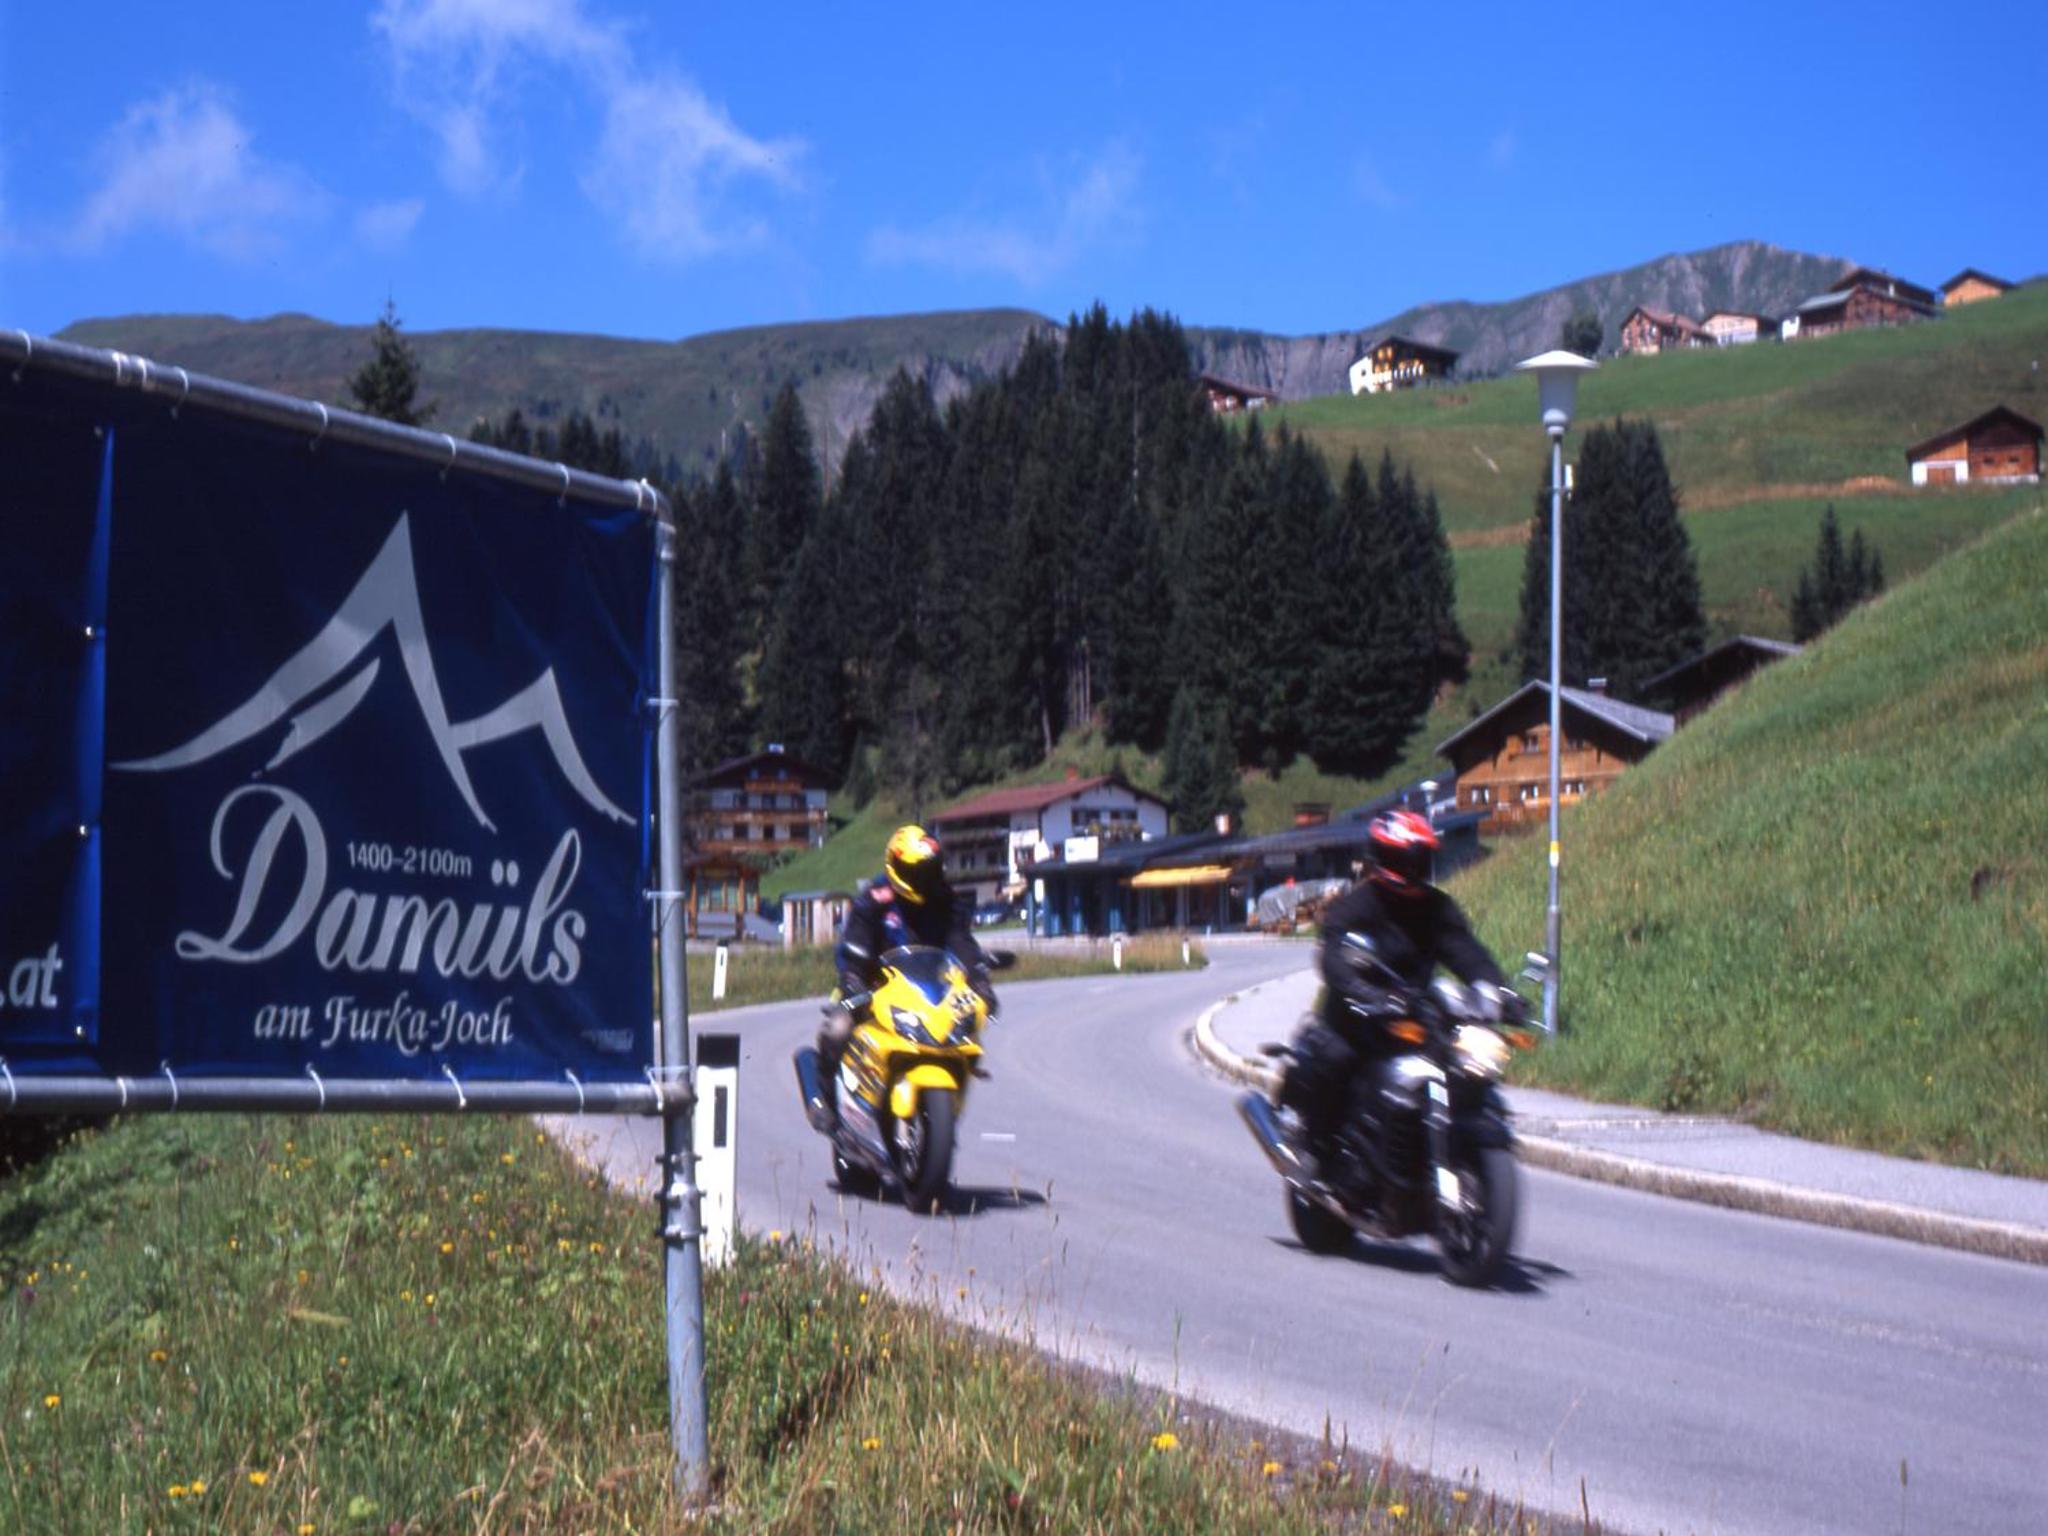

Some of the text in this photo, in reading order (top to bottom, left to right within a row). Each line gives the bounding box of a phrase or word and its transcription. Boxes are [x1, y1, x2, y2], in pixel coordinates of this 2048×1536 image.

[175, 783, 586, 985] Damüls
[347, 841, 472, 877] 1400-2100m
[253, 990, 515, 1058] am Furka-Joch
